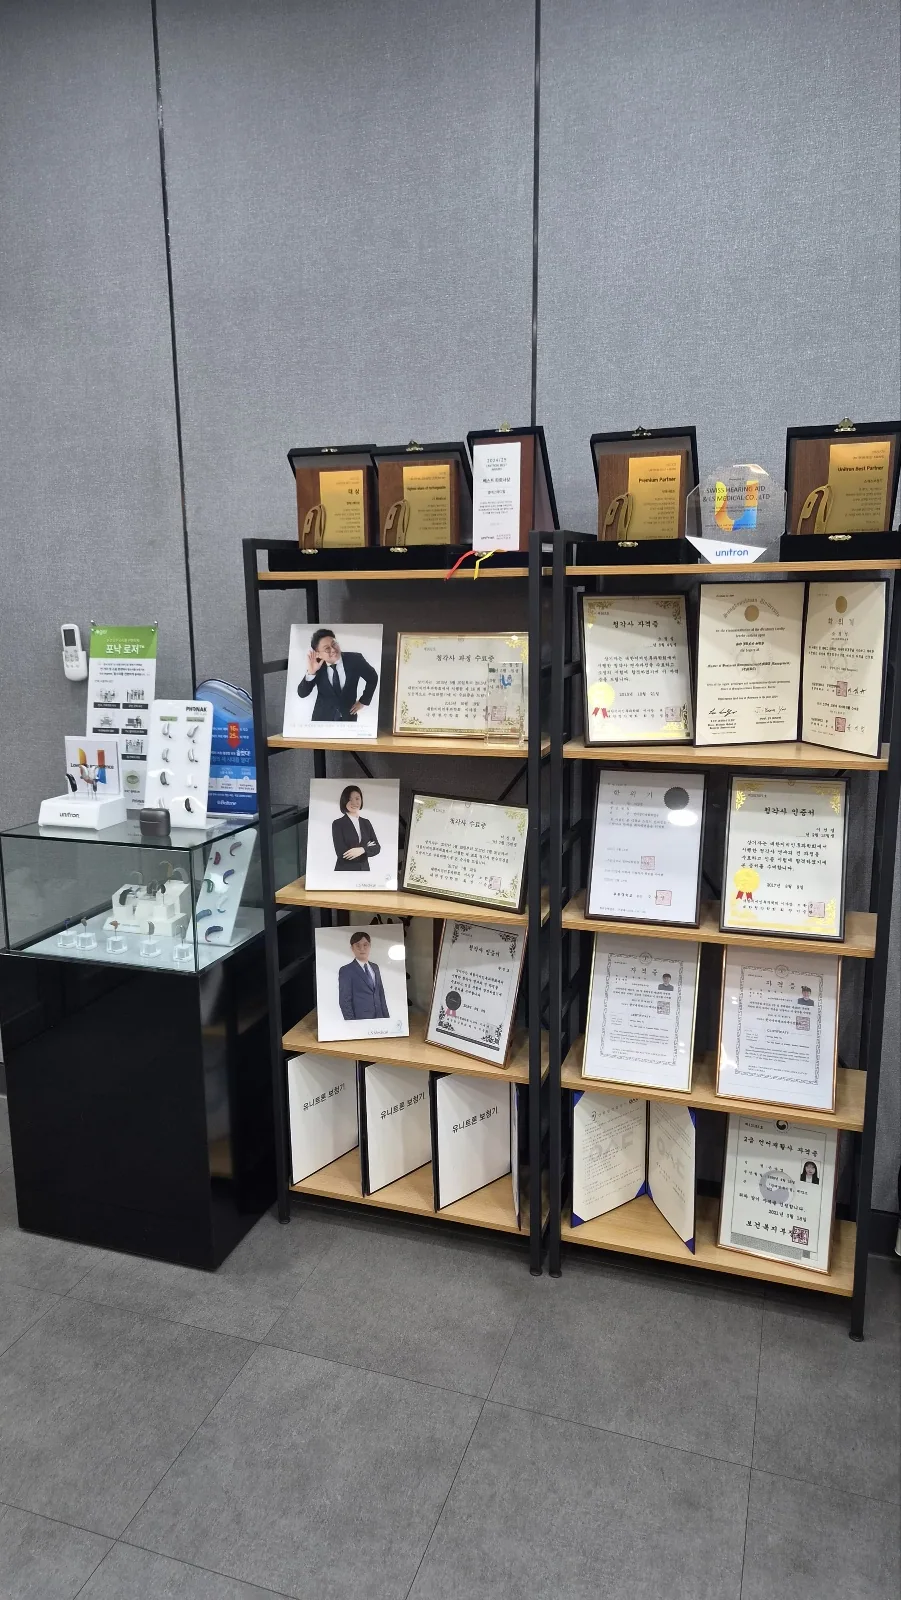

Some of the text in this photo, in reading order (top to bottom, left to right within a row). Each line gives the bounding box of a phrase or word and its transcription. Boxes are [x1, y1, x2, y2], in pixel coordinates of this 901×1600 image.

[613, 620, 634, 628] 청각사
[106, 644, 122, 654] 포낙
[764, 807, 815, 817] 청각사 인증서
[303, 1083, 345, 1111] 유니트론 보청기
[380, 1092, 426, 1120] 유니트론 보청기
[452, 1106, 498, 1133] 유니트론 보청기
[797, 1147, 818, 1157] 자격증
